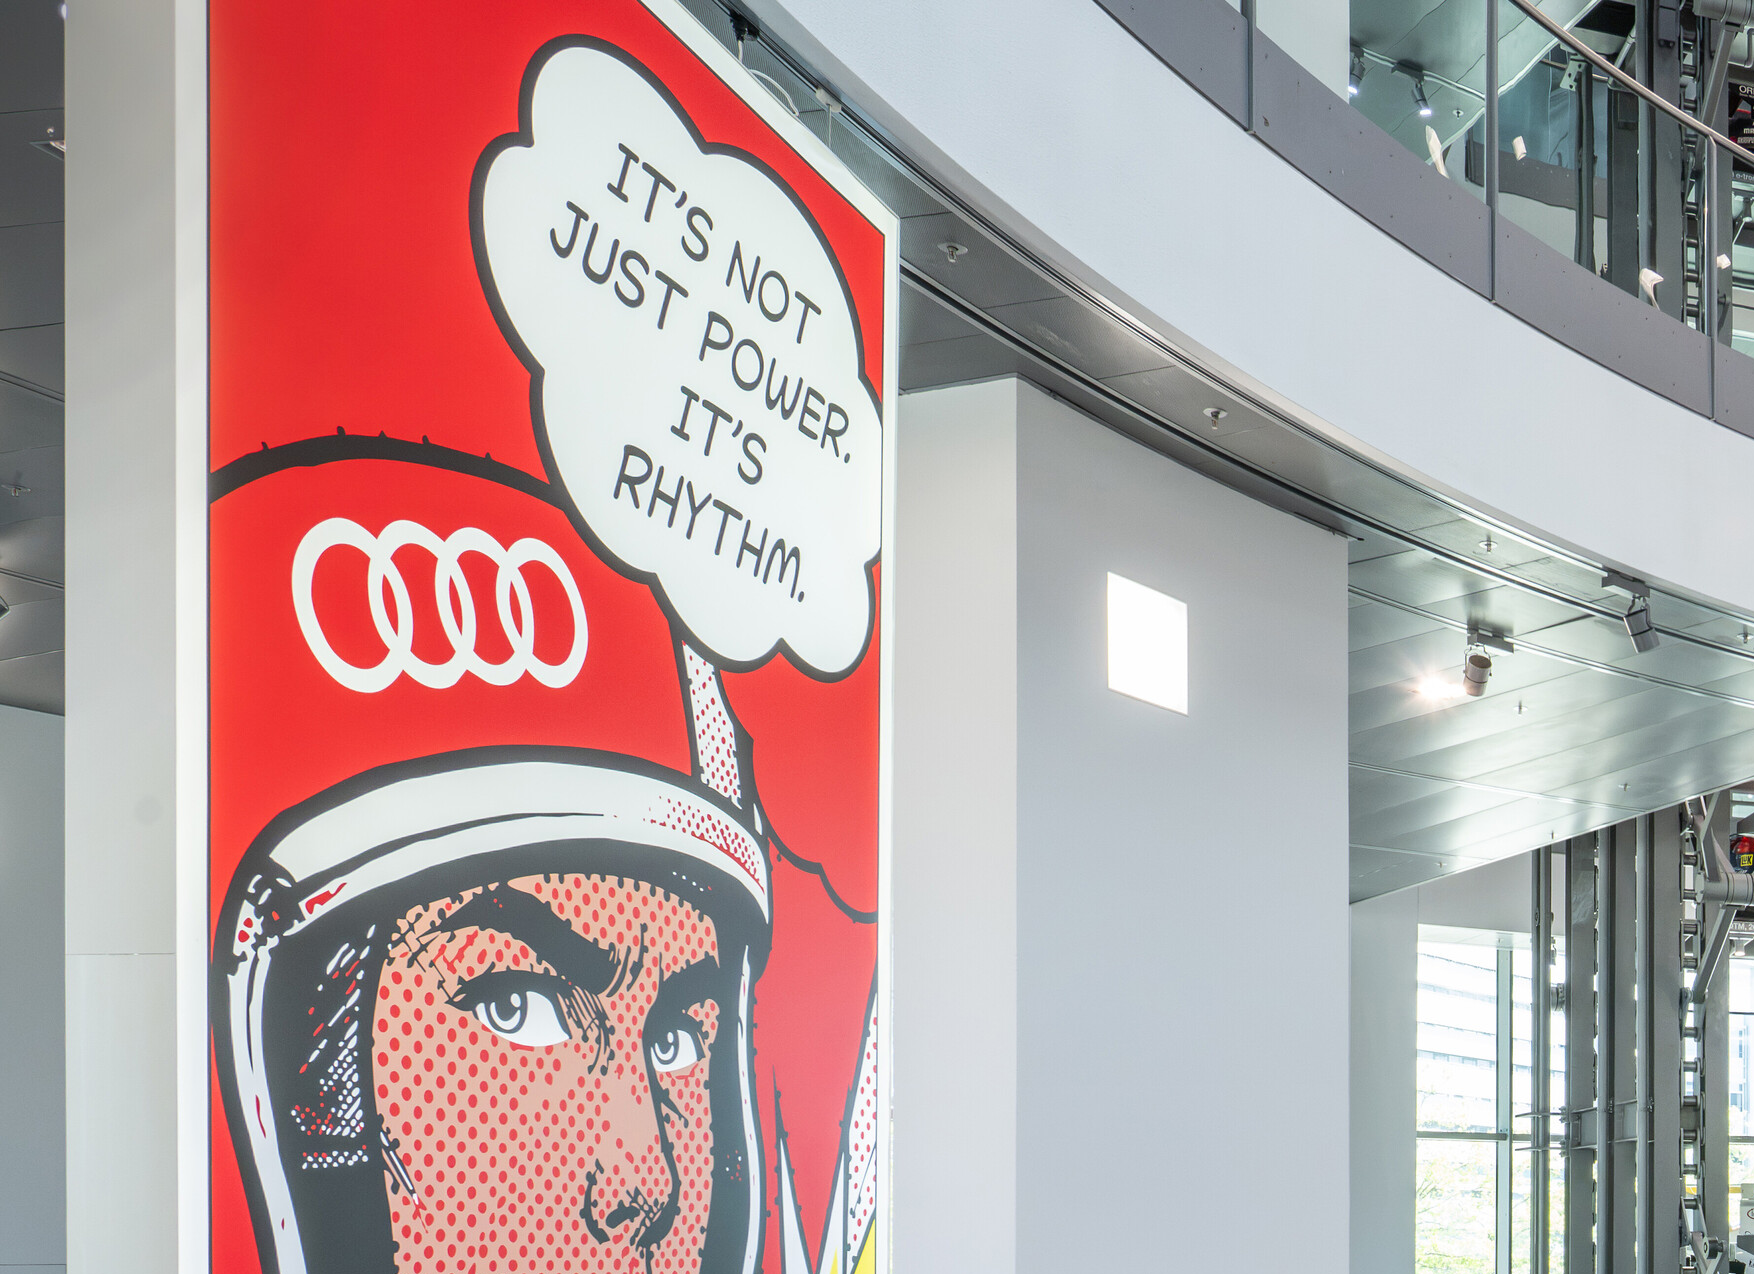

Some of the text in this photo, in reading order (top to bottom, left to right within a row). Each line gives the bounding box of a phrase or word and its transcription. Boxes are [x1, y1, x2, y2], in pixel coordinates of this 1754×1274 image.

[550, 200, 852, 465] JUST POWER.
[607, 142, 822, 345] IT'S NOT
[613, 445, 806, 603] RHYTHM.
[670, 385, 769, 486] IT'S
